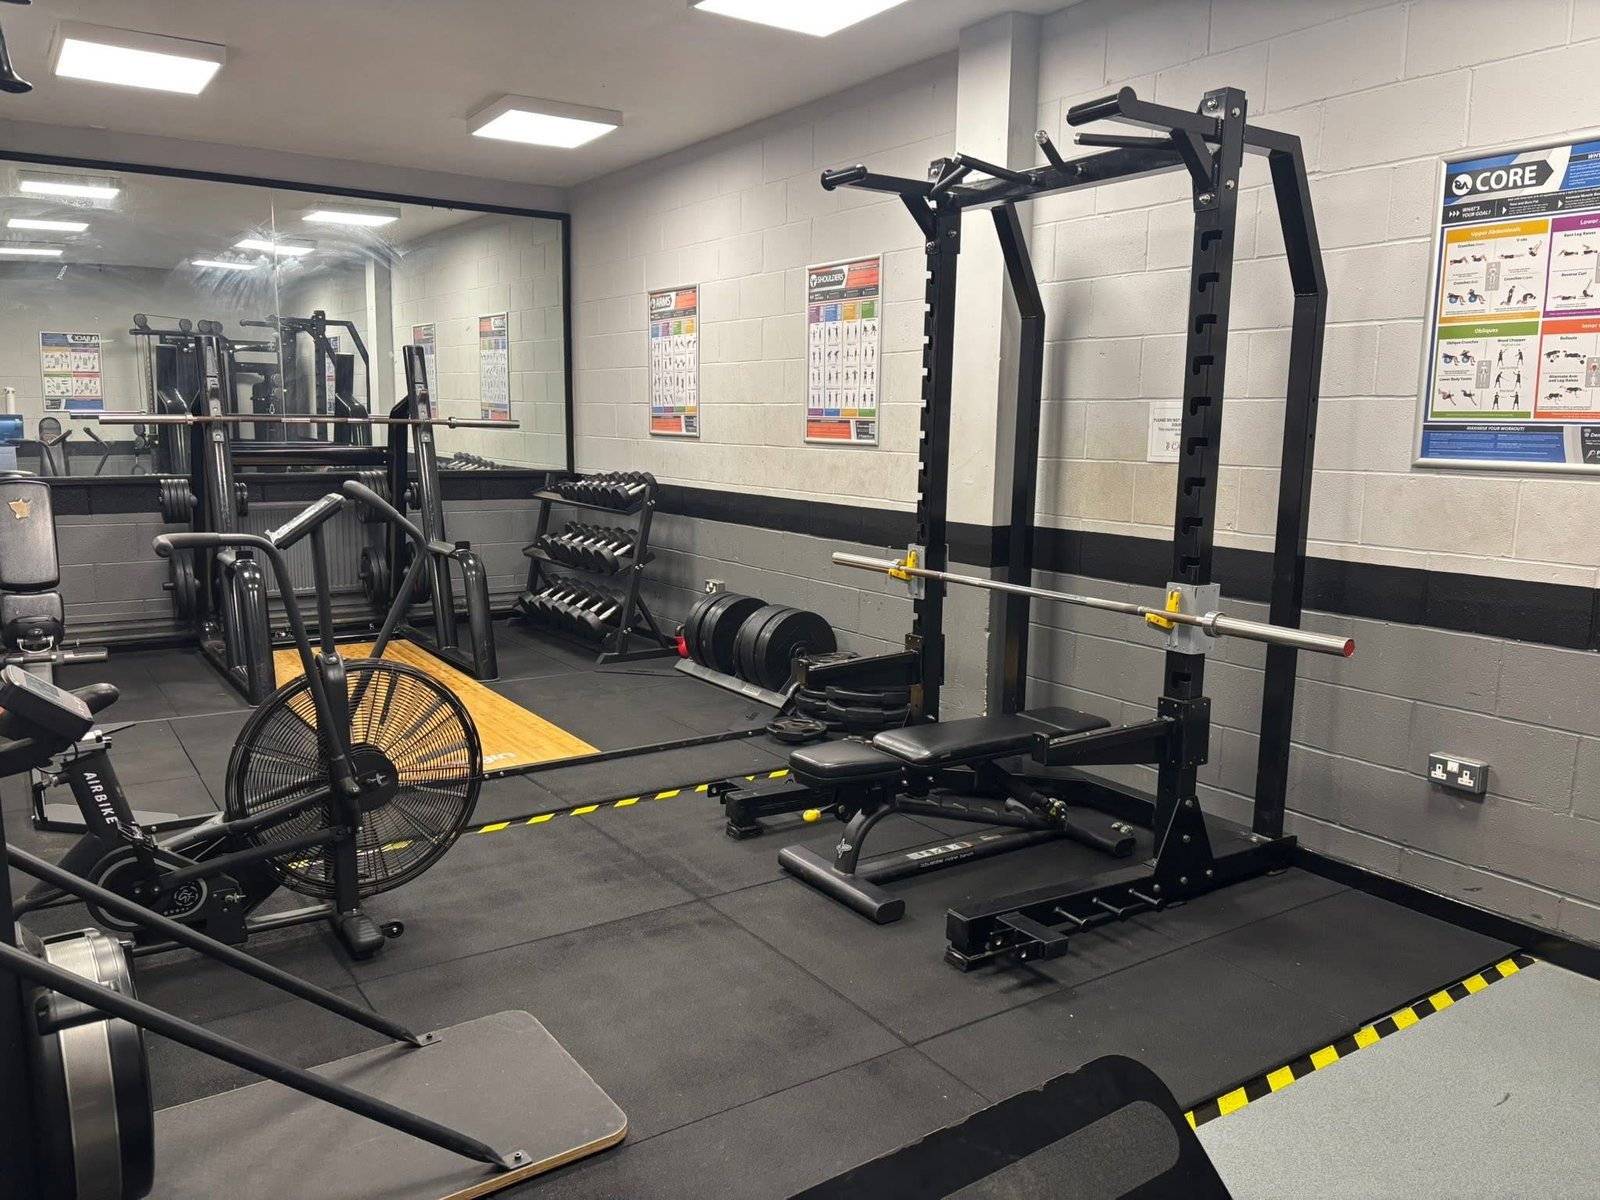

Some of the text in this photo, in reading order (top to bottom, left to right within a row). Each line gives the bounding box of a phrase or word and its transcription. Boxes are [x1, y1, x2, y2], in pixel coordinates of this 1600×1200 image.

[1476, 165, 1538, 191] CORE
[1488, 227, 1521, 235] Abdominals
[817, 273, 844, 284] SHOULDERS
[655, 296, 671, 308] ARMS
[83, 773, 119, 825] AIRBIKE
